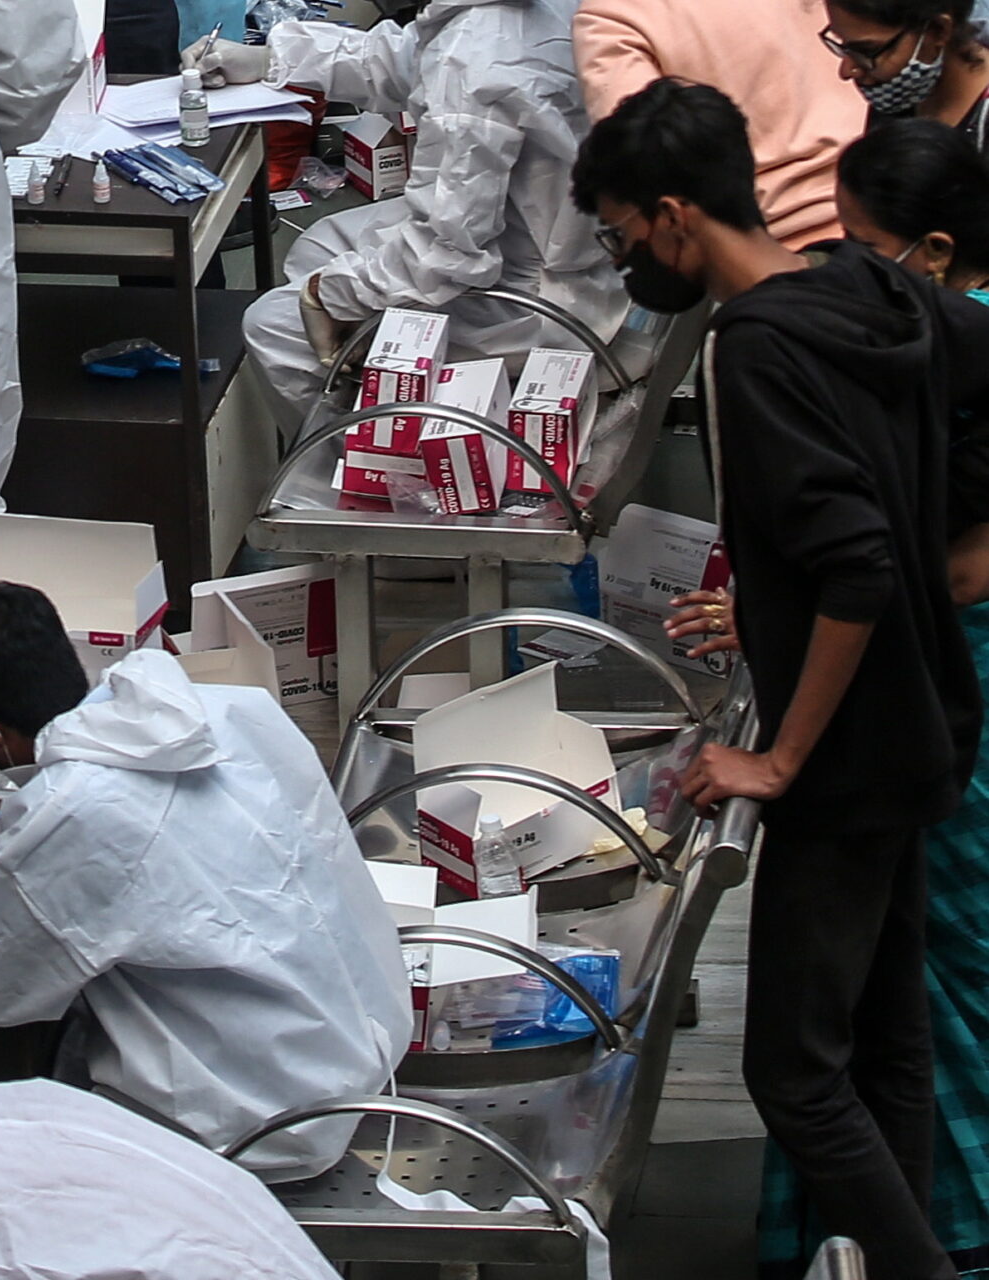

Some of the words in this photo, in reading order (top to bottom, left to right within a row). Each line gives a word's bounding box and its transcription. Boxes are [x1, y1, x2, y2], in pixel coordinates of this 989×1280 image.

[544, 414, 556, 457] COVID-19
[439, 458, 450, 471] Ag
[441, 472, 460, 514] COVID-19
